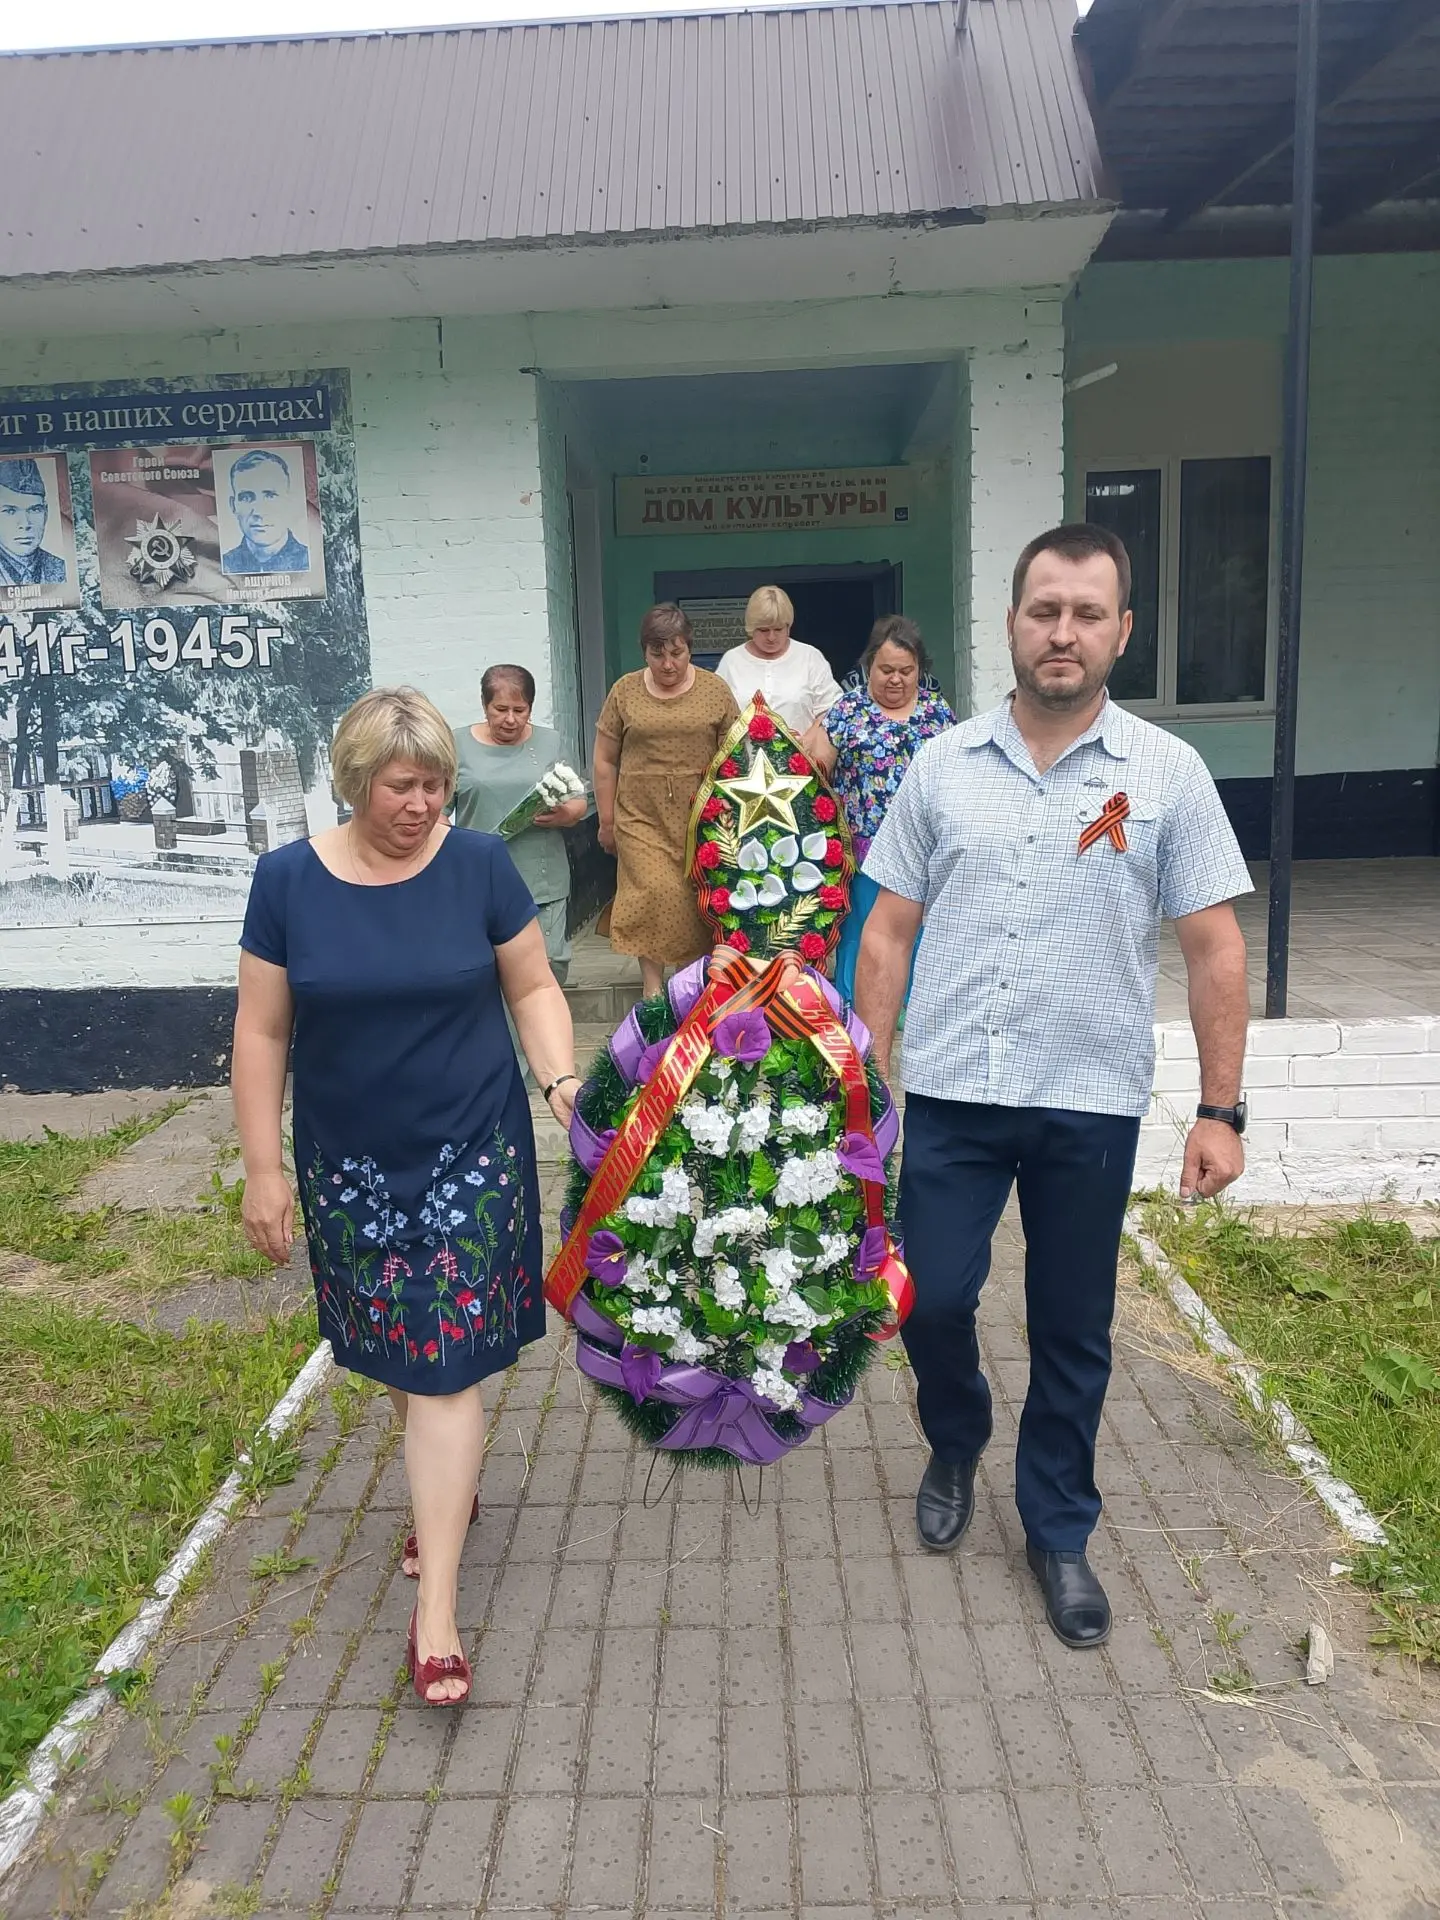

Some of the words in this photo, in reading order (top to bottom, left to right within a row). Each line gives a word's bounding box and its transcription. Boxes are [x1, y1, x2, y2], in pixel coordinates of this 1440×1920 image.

[36, 413, 54, 434] в
[63, 405, 174, 432] наших
[182, 390, 325, 433] сердцах!
[132, 456, 165, 469] Герой
[101, 470, 161, 483] Советского
[163, 468, 200, 481] Союза
[642, 498, 713, 523] ДОМ
[726, 490, 887, 520] КУЛЬТУРЫ
